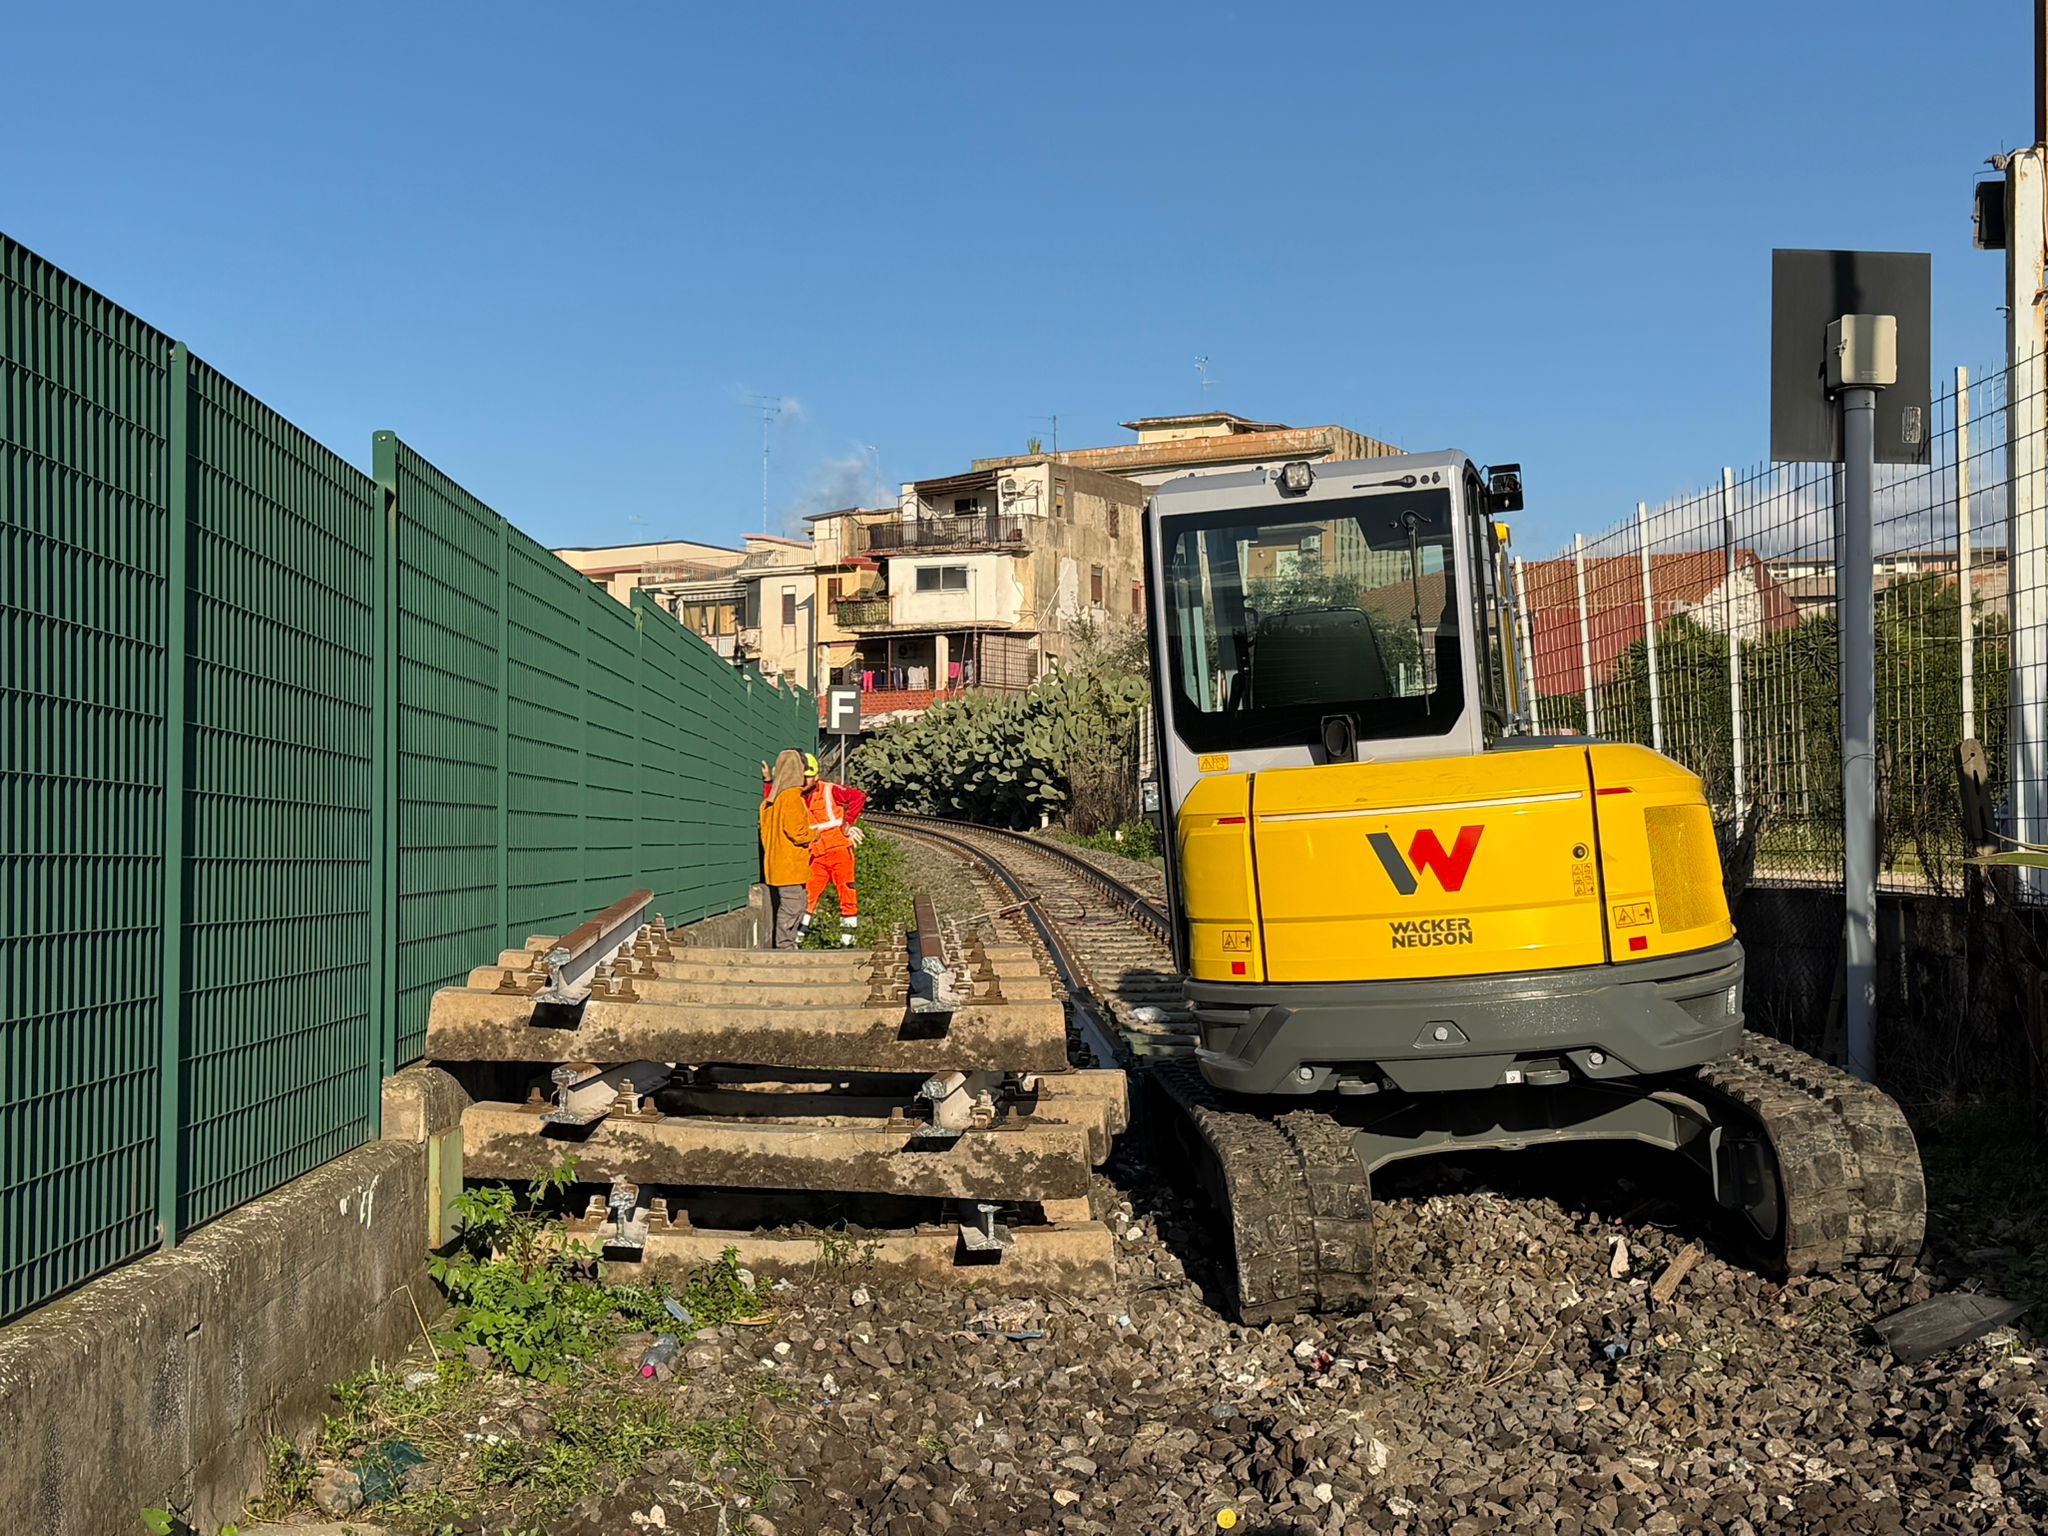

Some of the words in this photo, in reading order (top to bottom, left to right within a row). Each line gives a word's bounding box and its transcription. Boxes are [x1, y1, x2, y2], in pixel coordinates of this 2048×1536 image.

[831, 691, 856, 728] F
[1389, 918, 1471, 935] WACKER
[1391, 931, 1473, 948] NEUSON
